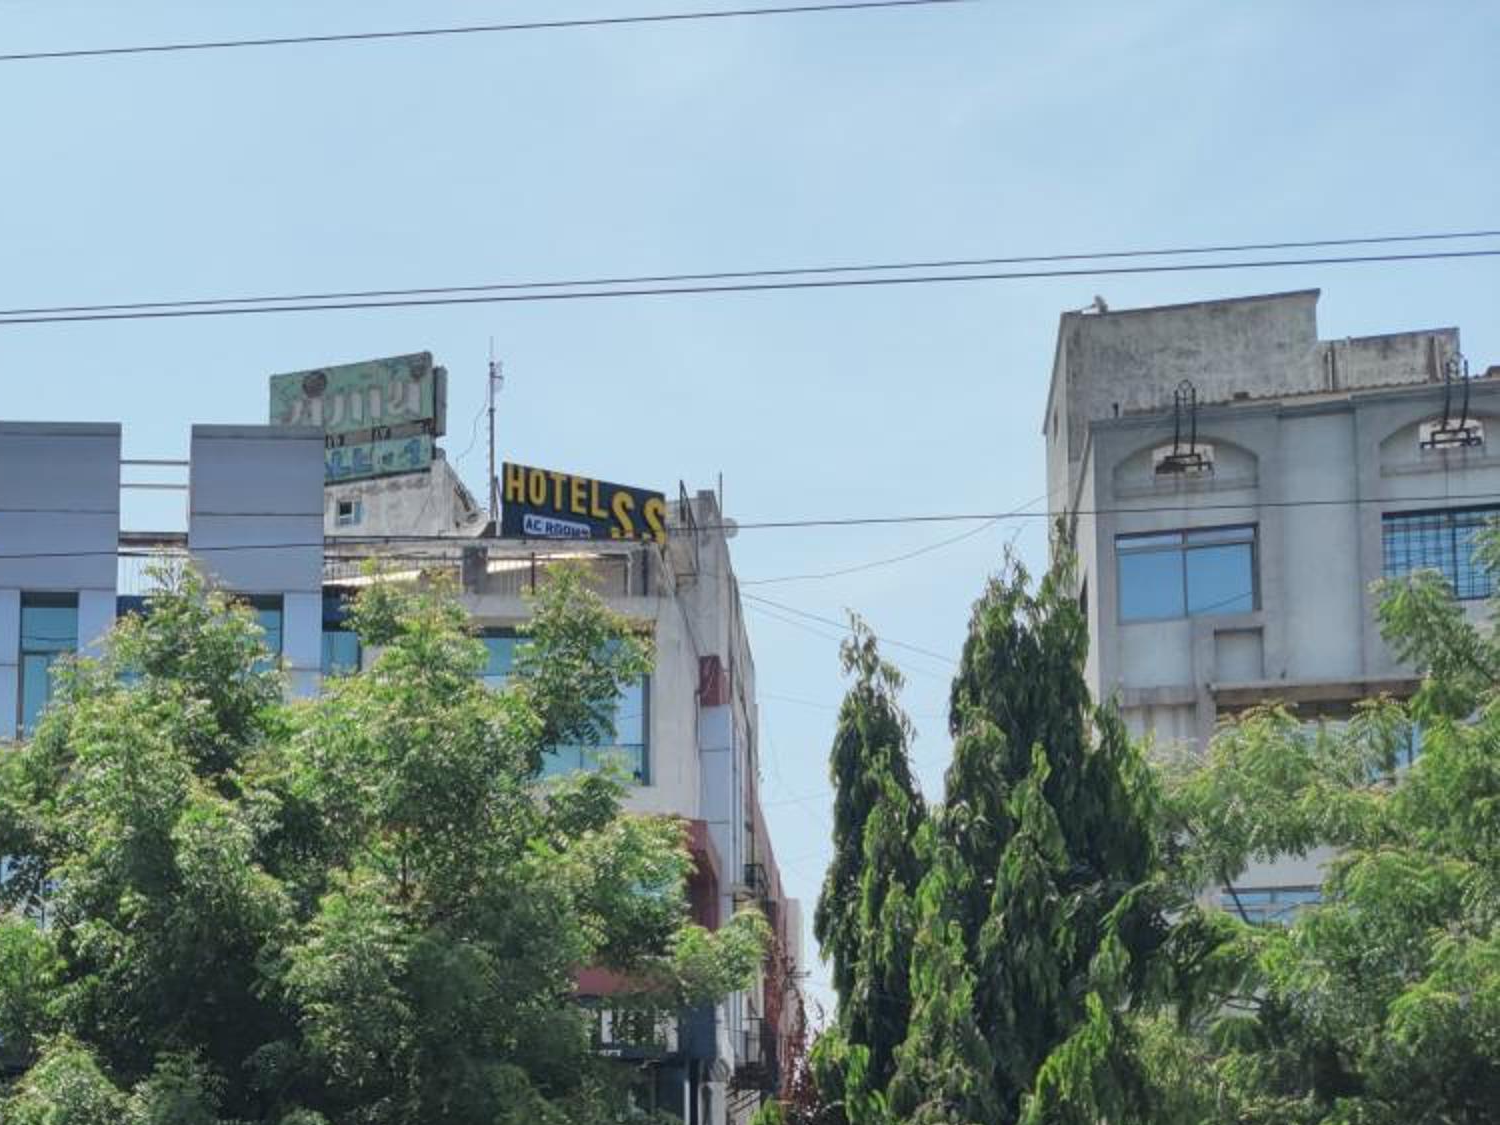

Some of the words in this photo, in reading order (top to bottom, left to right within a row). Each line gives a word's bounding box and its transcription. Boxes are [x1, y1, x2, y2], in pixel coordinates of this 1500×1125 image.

[505, 464, 608, 518] HOTEL
[526, 516, 543, 532] AC
[545, 519, 590, 537] ROOMS
